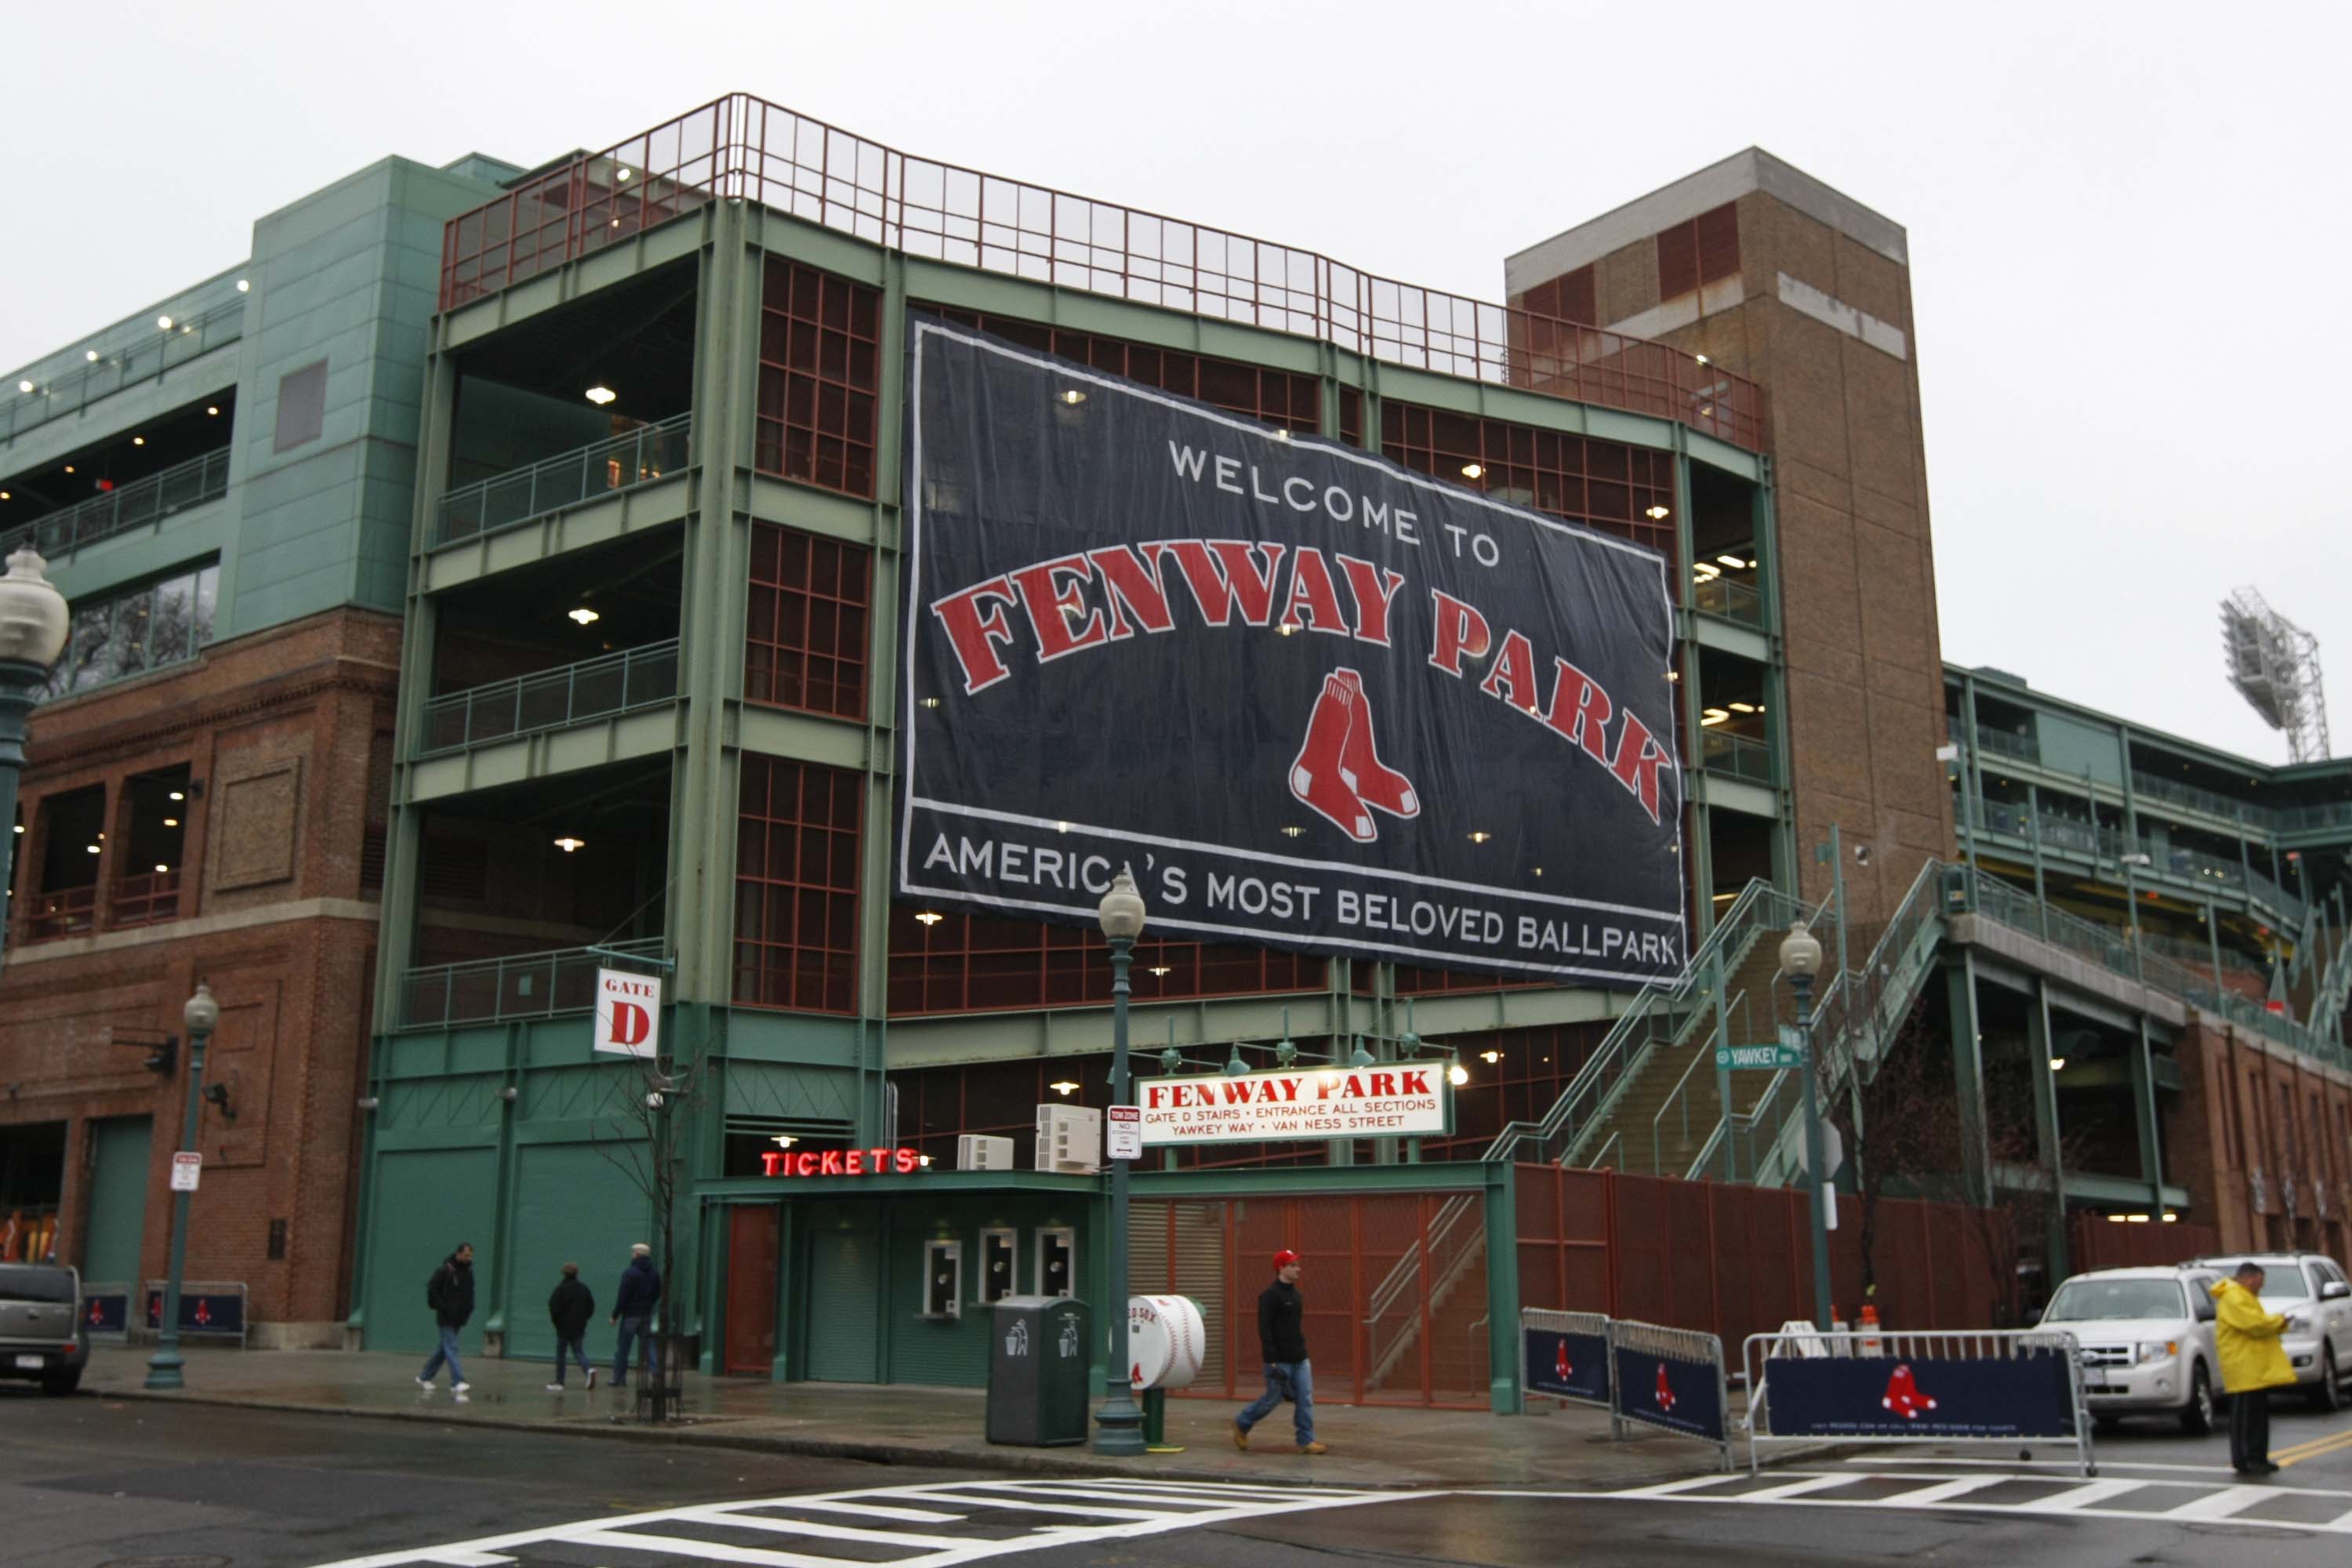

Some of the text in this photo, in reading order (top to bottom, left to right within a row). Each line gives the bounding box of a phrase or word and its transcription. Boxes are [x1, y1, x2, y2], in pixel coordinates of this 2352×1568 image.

[1169, 441, 1500, 568] WELCOME TO
[931, 538, 1673, 825] FENWAY PARK
[1207, 872, 1320, 920] MOST
[1337, 889, 1504, 944] BELOVED
[1517, 916, 1678, 966] BALLPARK
[605, 978, 654, 998] GATE
[608, 1000, 650, 1045] D
[1730, 1047, 1778, 1065] YAWKEY
[1148, 1070, 1431, 1109] FENWAY PARK
[1145, 1099, 1436, 1123] GATE D STAIRS ENTRANCE ALL SECTIONS
[1173, 1115, 1404, 1136] YAWKEY WAY VAN NESS STREET
[761, 1148, 920, 1177] TICKETS
